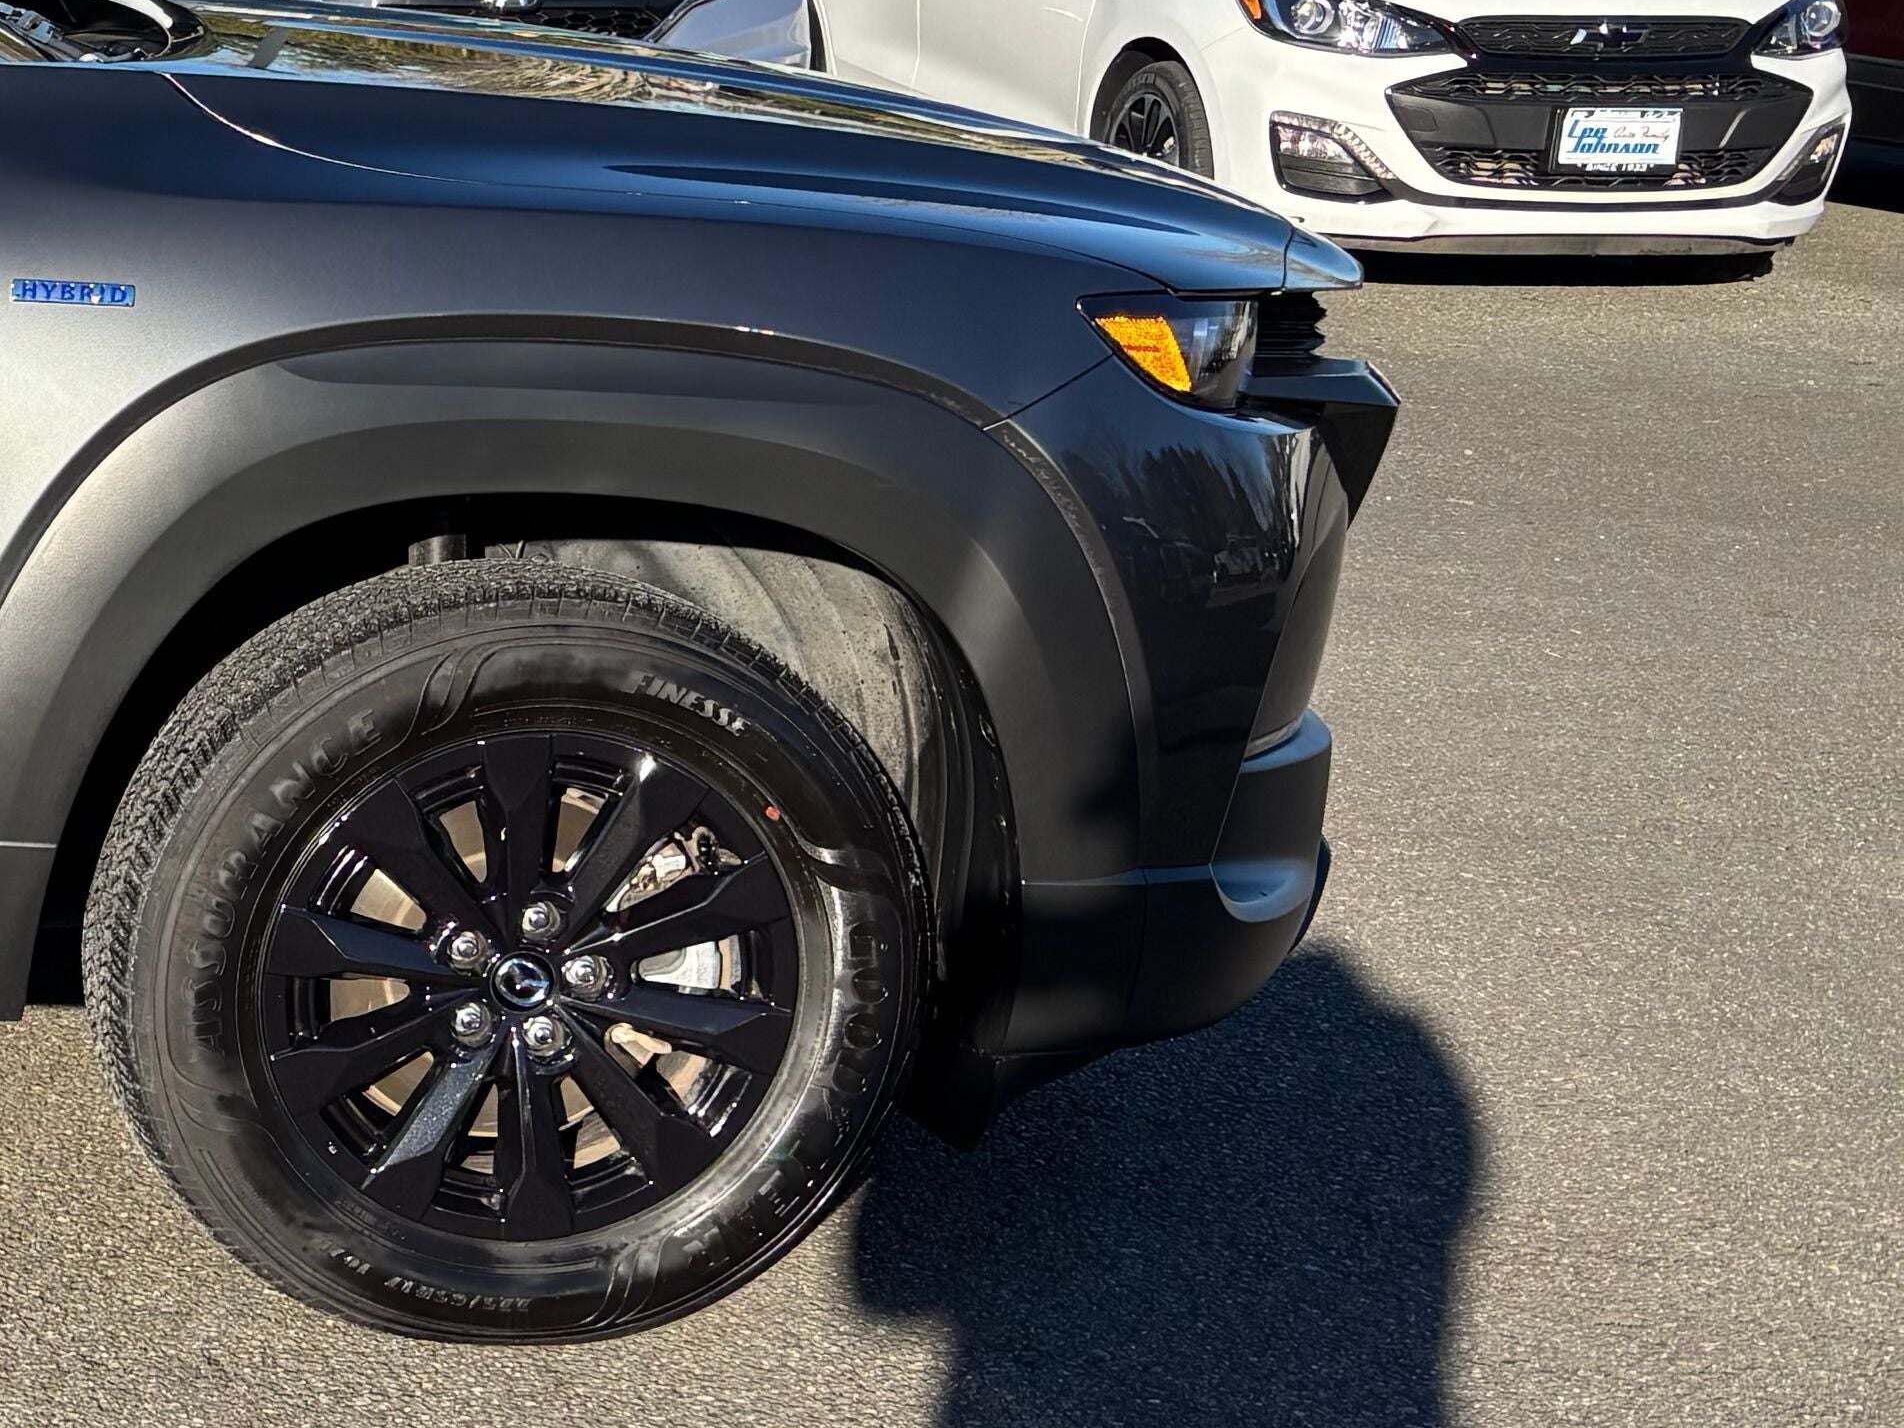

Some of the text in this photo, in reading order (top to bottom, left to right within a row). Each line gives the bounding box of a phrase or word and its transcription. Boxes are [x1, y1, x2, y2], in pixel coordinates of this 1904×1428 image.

[1567, 120, 1607, 139] Lee
[1566, 134, 1659, 154] Johnson
[21, 281, 128, 303] HYBRID
[625, 671, 752, 737] FINESSE
[185, 709, 382, 1058] ASSURANCE
